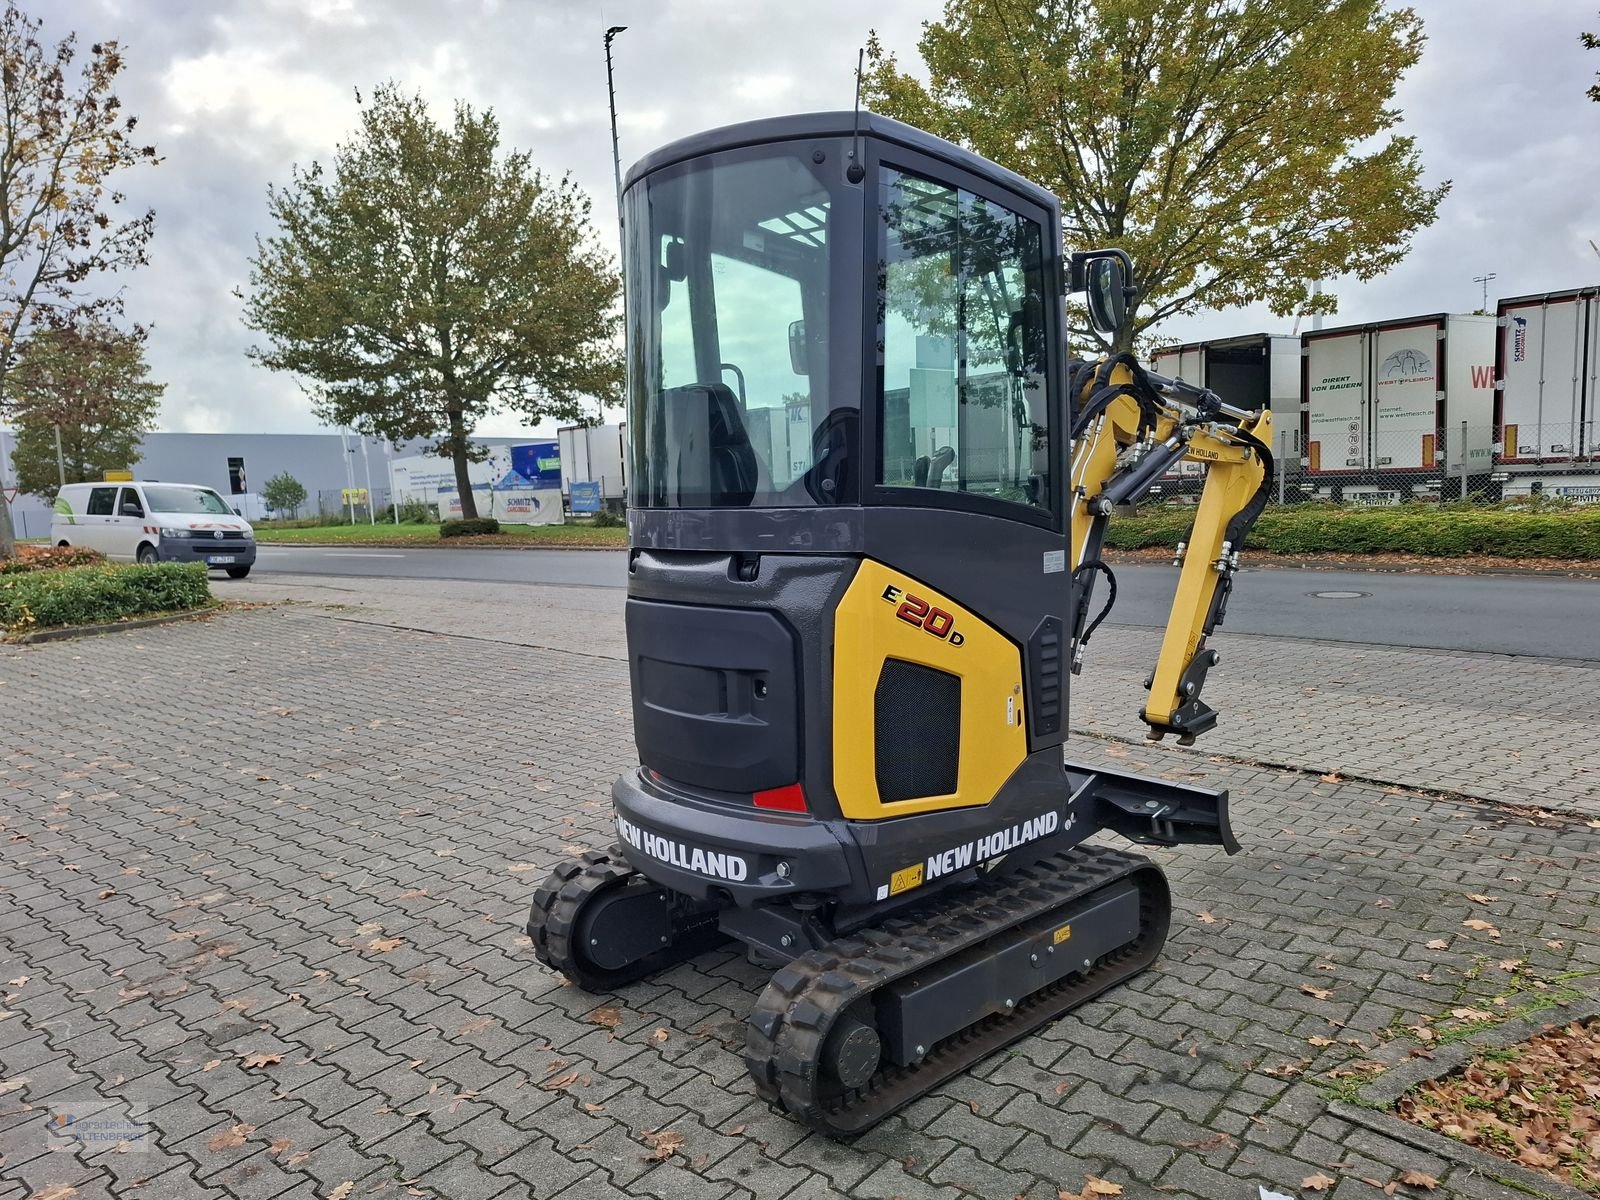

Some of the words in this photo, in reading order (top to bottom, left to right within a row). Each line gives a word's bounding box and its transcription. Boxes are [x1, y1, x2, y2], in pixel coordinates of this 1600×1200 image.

[1322, 375, 1351, 385] DIREKT
[1311, 385, 1327, 393] VON
[1329, 382, 1363, 391] BAUERN
[1195, 448, 1219, 460] HOLLAND
[507, 497, 531, 506] SCHMITZ
[615, 813, 642, 851] NEW
[643, 831, 748, 882] HOLLAND
[926, 842, 974, 881] NEW
[976, 810, 1058, 862] HOLLAND
